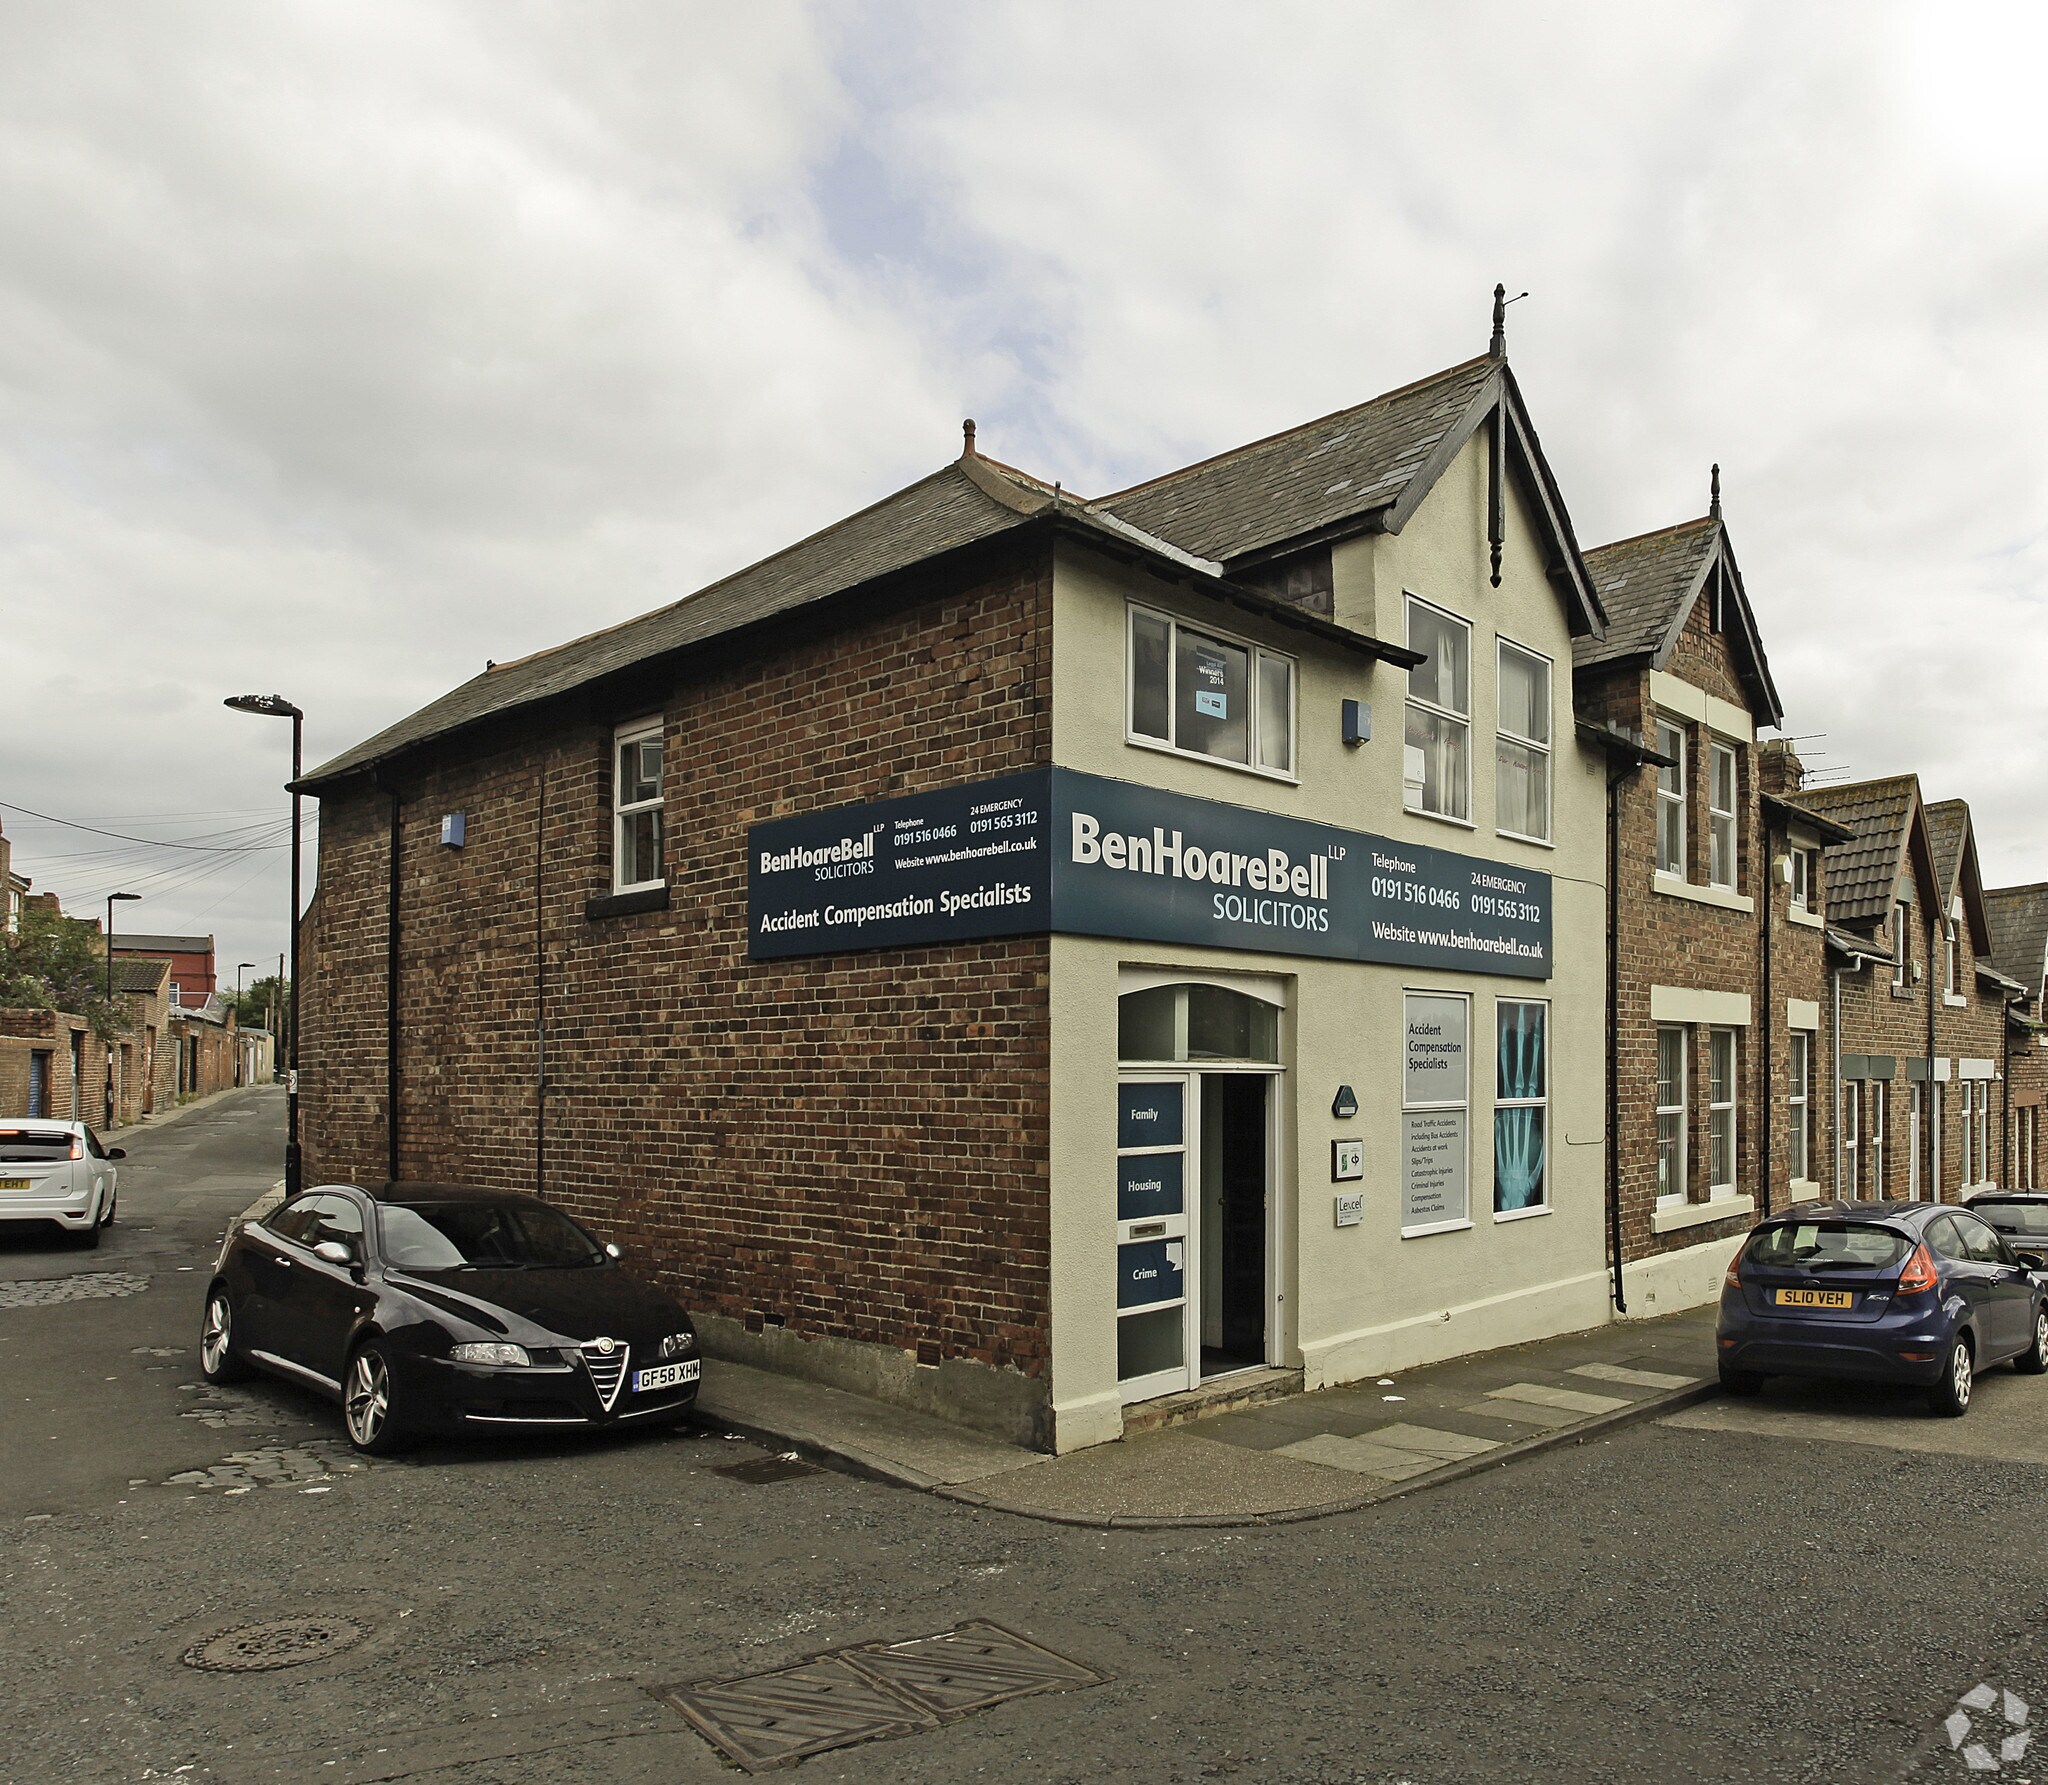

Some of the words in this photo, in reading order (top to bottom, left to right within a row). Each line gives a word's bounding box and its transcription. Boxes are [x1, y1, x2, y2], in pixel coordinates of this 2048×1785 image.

[1209, 676, 1224, 686] 2014
[970, 806, 979, 816] 24
[980, 798, 1023, 814] EMERGENCY
[873, 823, 885, 833] LLP
[894, 817, 924, 830] Telephone
[970, 817, 993, 834] 0191
[994, 815, 1013, 831] 565
[1014, 811, 1038, 828] 3112
[894, 831, 915, 847] 0191
[915, 829, 931, 844] 516
[933, 825, 957, 841] 0466
[760, 832, 874, 874] BenHoareBell
[894, 856, 925, 870] Website
[925, 837, 1038, 865] www.benhoarebell.co.uk
[1071, 811, 1328, 900] BenHoareBell
[1328, 844, 1346, 861] LLP
[814, 860, 874, 881] SOLICITORS
[1372, 852, 1416, 874] Telephone
[1471, 872, 1481, 885] 24
[1482, 874, 1526, 895] EMERGENCY
[1371, 876, 1401, 901] 0191
[1404, 883, 1426, 904] 516
[1429, 887, 1460, 910] 0466
[760, 909, 819, 933] Accident
[824, 894, 934, 927] Compensation
[939, 882, 1032, 916] Specialists
[1213, 893, 1329, 932] SOLICITORS
[1471, 894, 1496, 916] 0191
[1498, 899, 1517, 919] 565
[1518, 903, 1540, 923] 3112
[1372, 921, 1416, 943] Website
[1417, 929, 1544, 959] www.benhoarebell.co.uk
[1408, 1023, 1441, 1037] Accident
[1408, 1040, 1462, 1055] Compensation
[1408, 1057, 1448, 1072] Specialists
[1131, 1109, 1158, 1122] Family
[1411, 1120, 1422, 1128] Road
[1411, 1132, 1430, 1141] including
[1411, 1144, 1431, 1152] Accidents
[1438, 1143, 1448, 1151] work
[1411, 1157, 1433, 1166] Slips/Trips
[1411, 1168, 1438, 1177] Catastrophic
[1439, 1167, 1453, 1176] Injuries
[1128, 1179, 1162, 1194] Housing
[1411, 1181, 1428, 1190] Criminal
[1429, 1180, 1444, 1189] Injuries
[1411, 1193, 1441, 1202] Compensation
[1411, 1205, 1430, 1214] Asbestos
[1431, 1204, 1445, 1212] Claims
[1132, 1268, 1158, 1281] Crime
[1784, 1290, 1814, 1304] SL10
[1818, 1292, 1845, 1305] VEH
[642, 1367, 675, 1387] GF58
[679, 1361, 698, 1380] XHM
